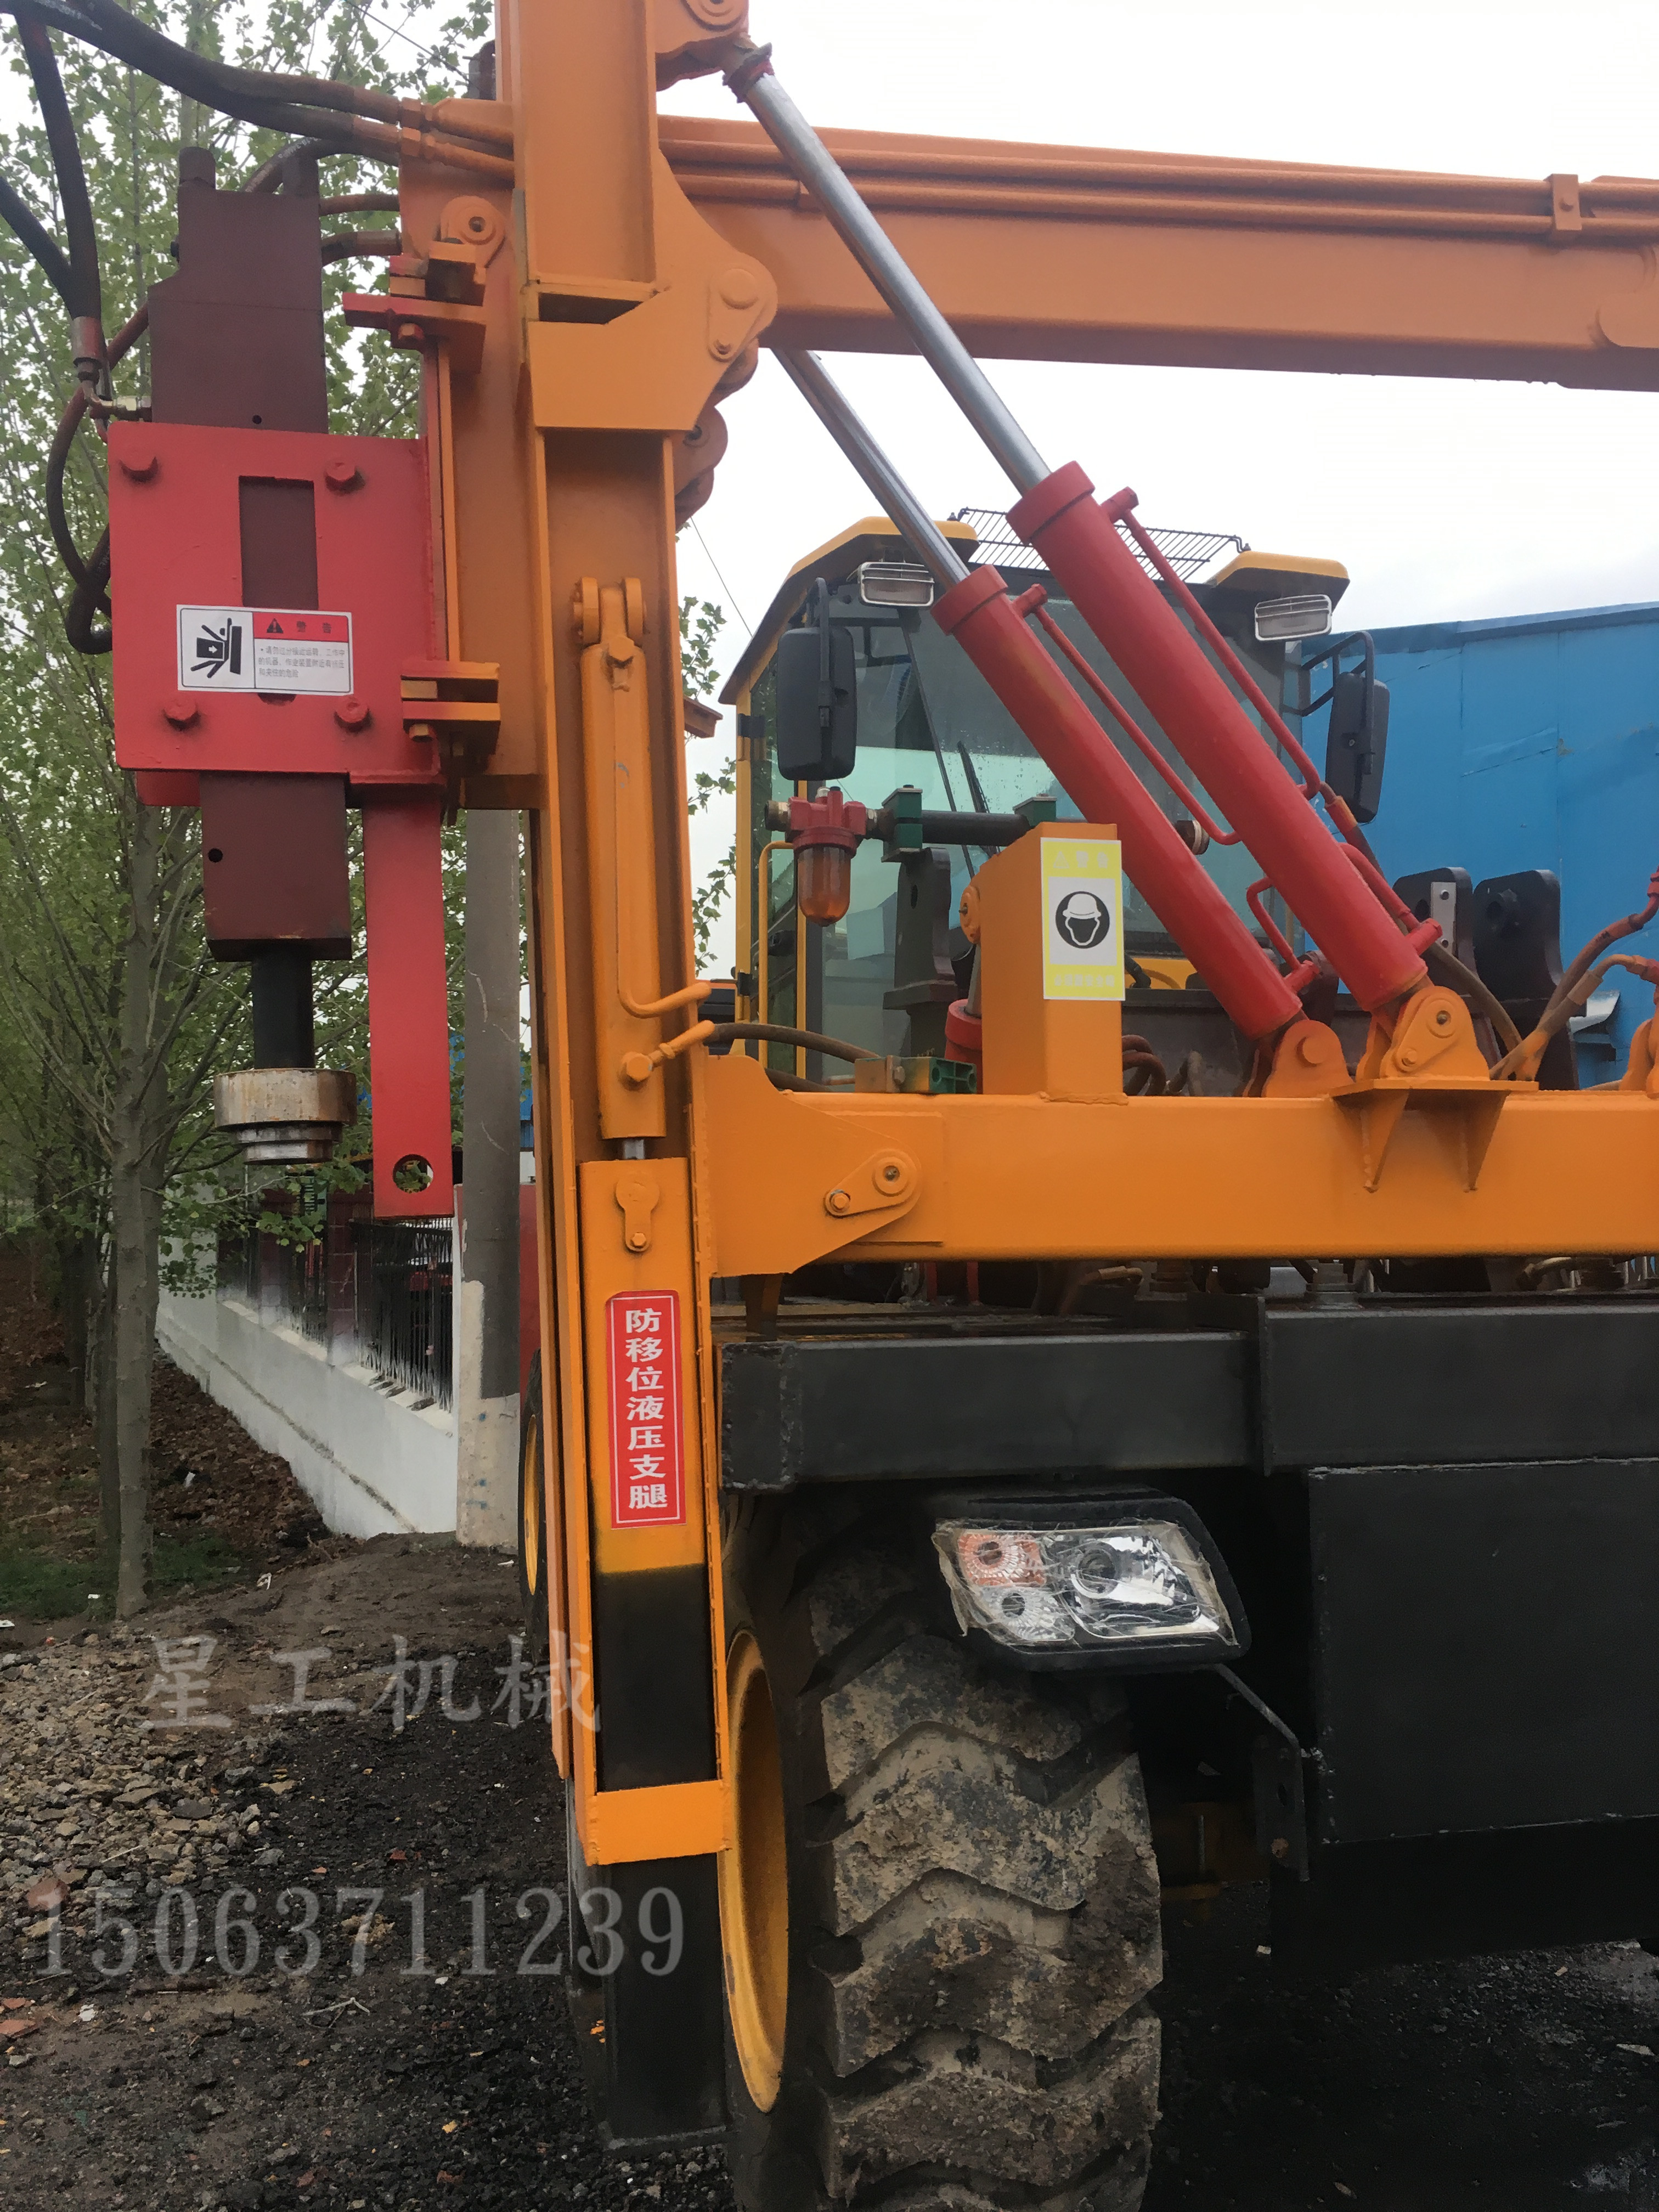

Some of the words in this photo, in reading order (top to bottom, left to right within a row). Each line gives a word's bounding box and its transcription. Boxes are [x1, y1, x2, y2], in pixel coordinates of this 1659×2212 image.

[297, 621, 331, 634] 警告
[625, 1308, 668, 1509] 防移位液压支腿
